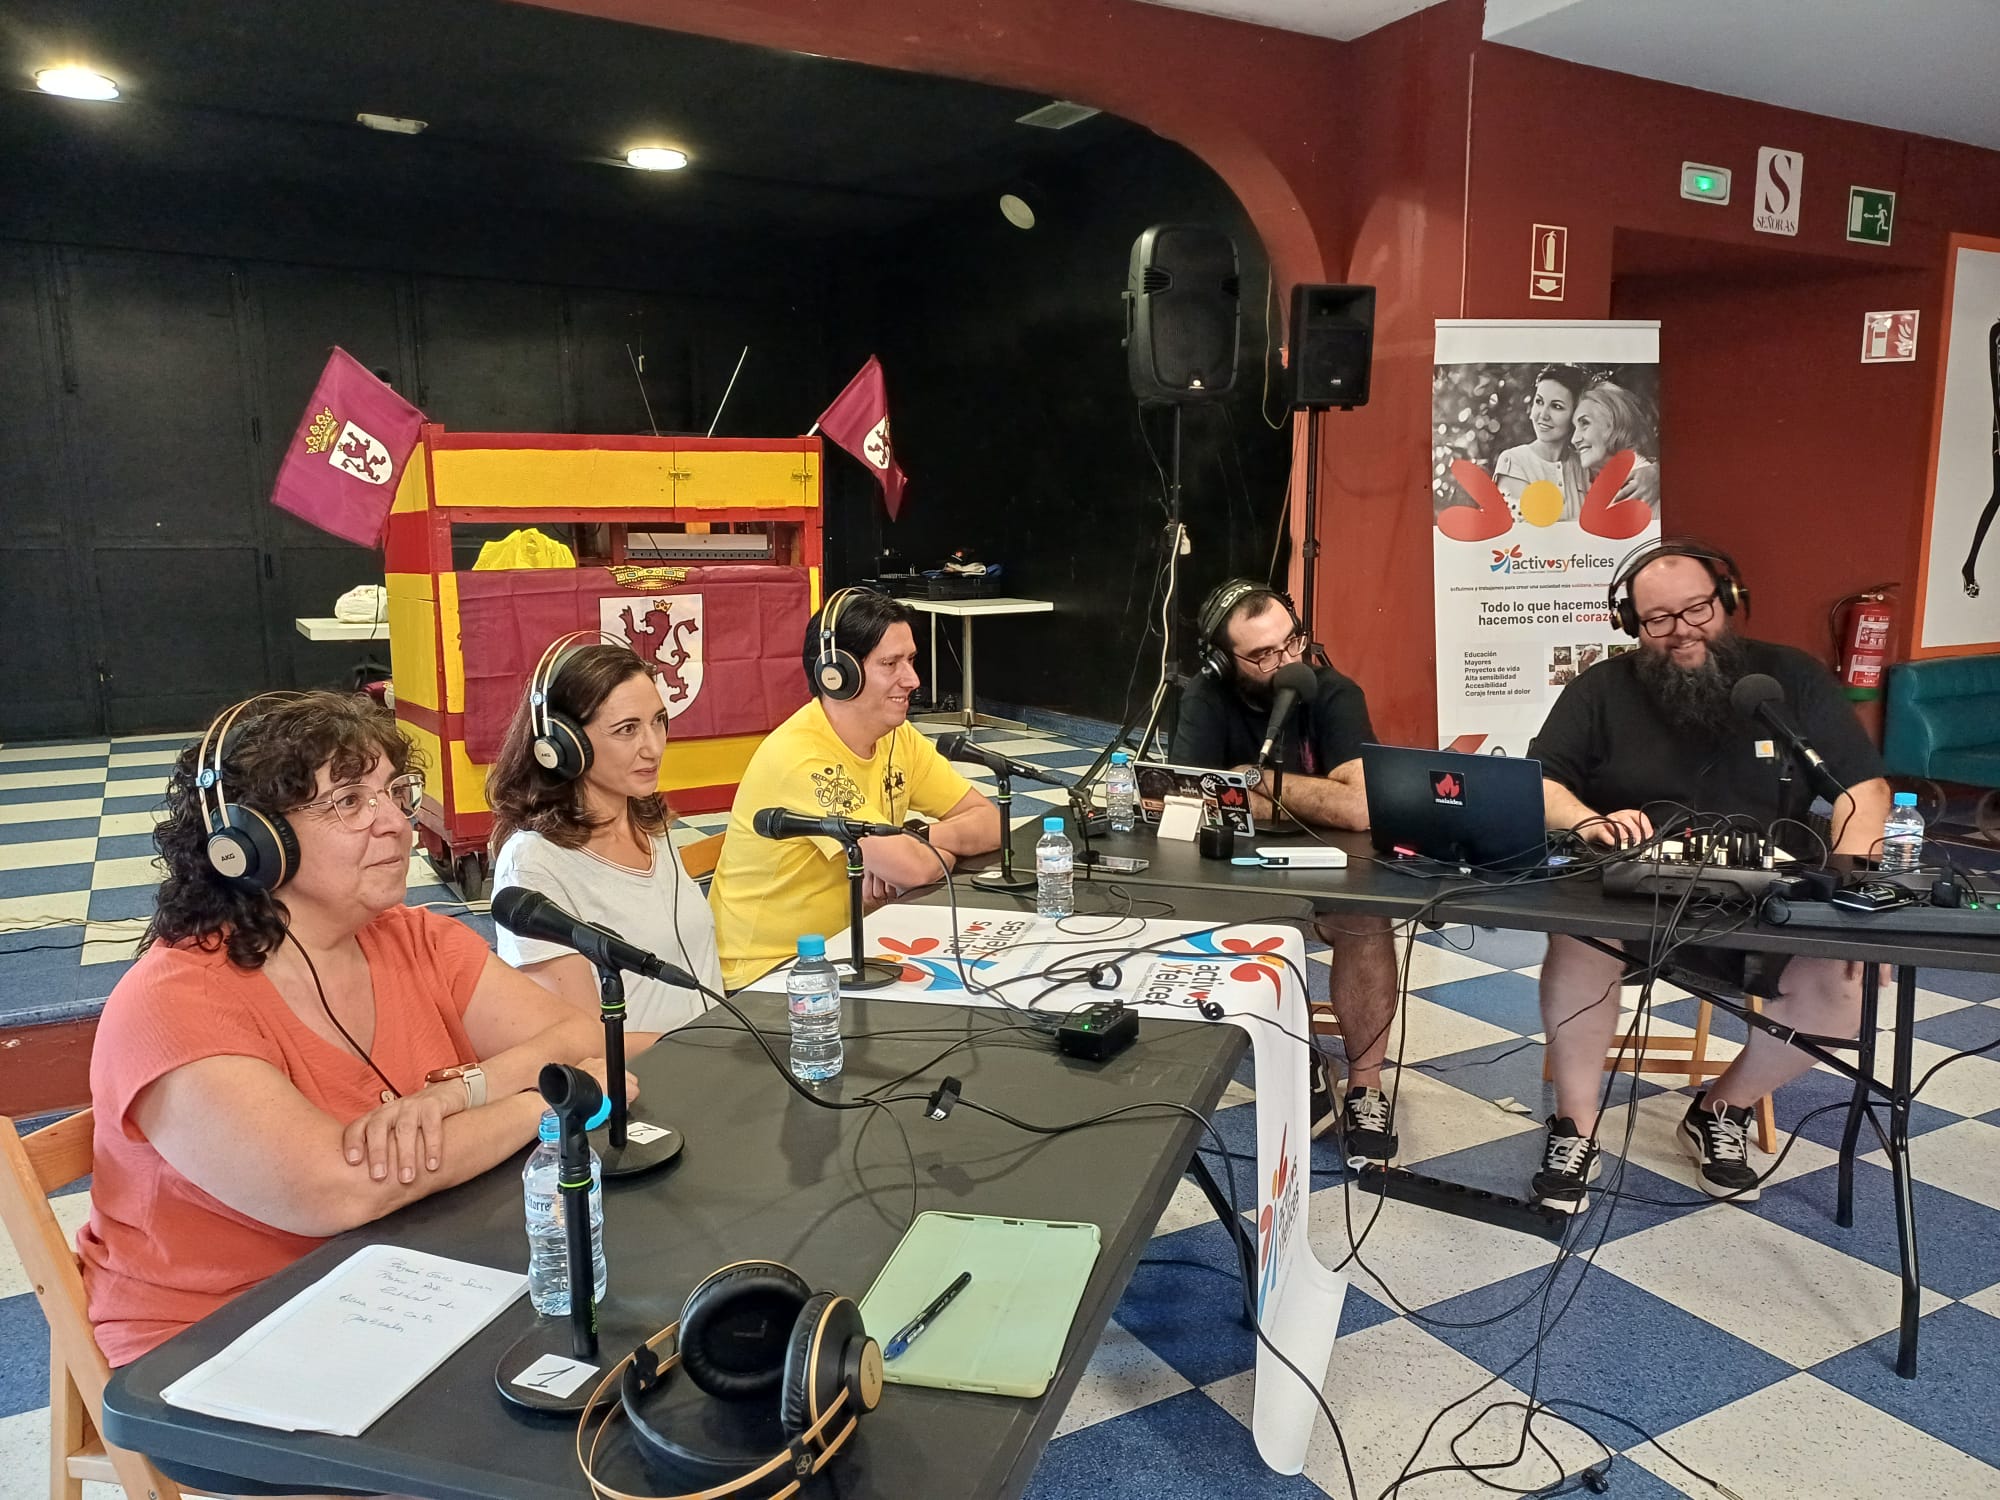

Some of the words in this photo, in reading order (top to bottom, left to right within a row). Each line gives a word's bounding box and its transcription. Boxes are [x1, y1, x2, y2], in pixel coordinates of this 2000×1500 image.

[1764, 153, 1792, 214] S
[1756, 215, 1795, 232] SEÑORAS
[1480, 602, 1510, 613] Todo
[1513, 601, 1524, 612] lo
[1527, 602, 1551, 614] que
[1553, 600, 1608, 611] hacemos
[1478, 614, 1534, 626] hacemos
[1536, 615, 1560, 624] con
[1562, 612, 1573, 623] el
[221, 852, 236, 862] AKG
[527, 1365, 576, 1388] 1
